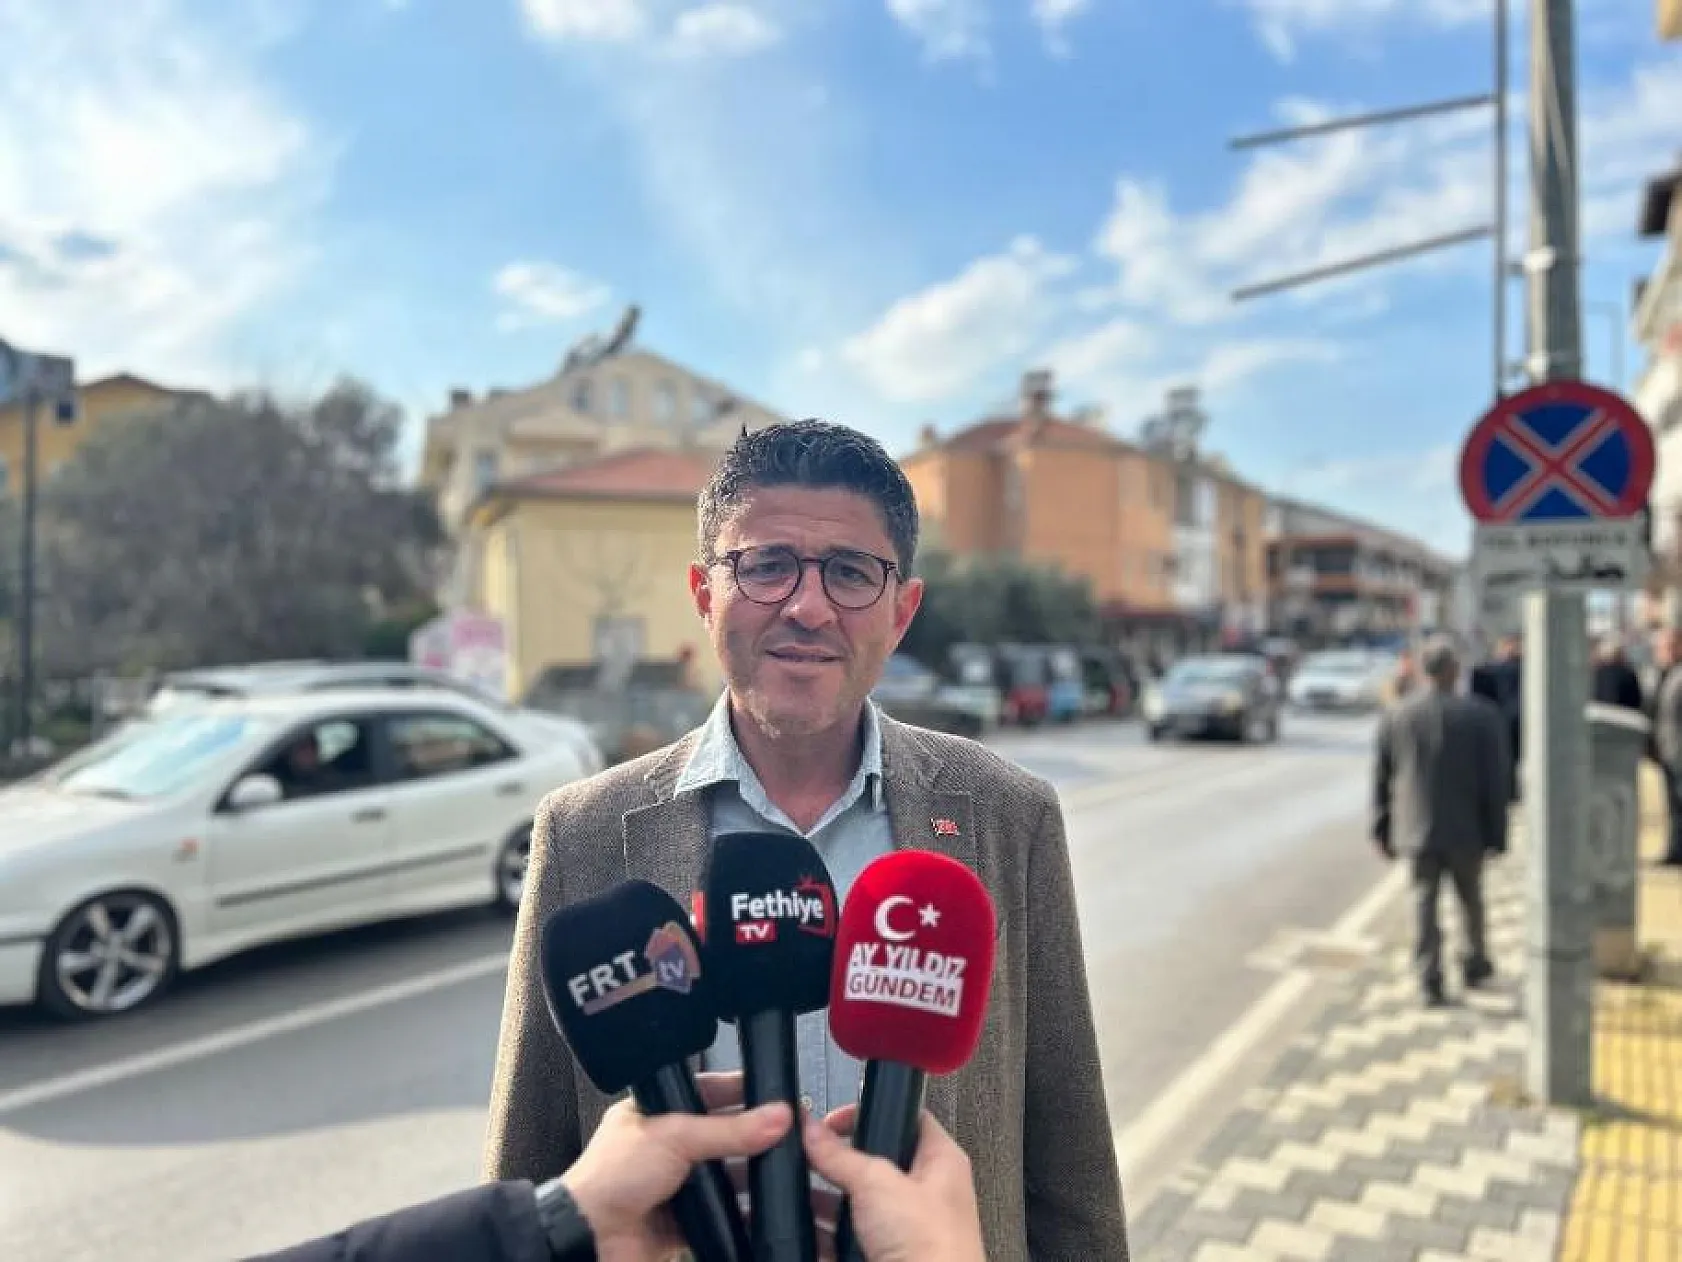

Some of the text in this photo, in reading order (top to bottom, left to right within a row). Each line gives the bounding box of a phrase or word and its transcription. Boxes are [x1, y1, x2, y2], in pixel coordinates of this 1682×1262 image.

[731, 889, 824, 925] Fethiye
[739, 922, 771, 940] TV
[568, 950, 636, 1007] FRT
[848, 942, 968, 980] AY YILDIZ
